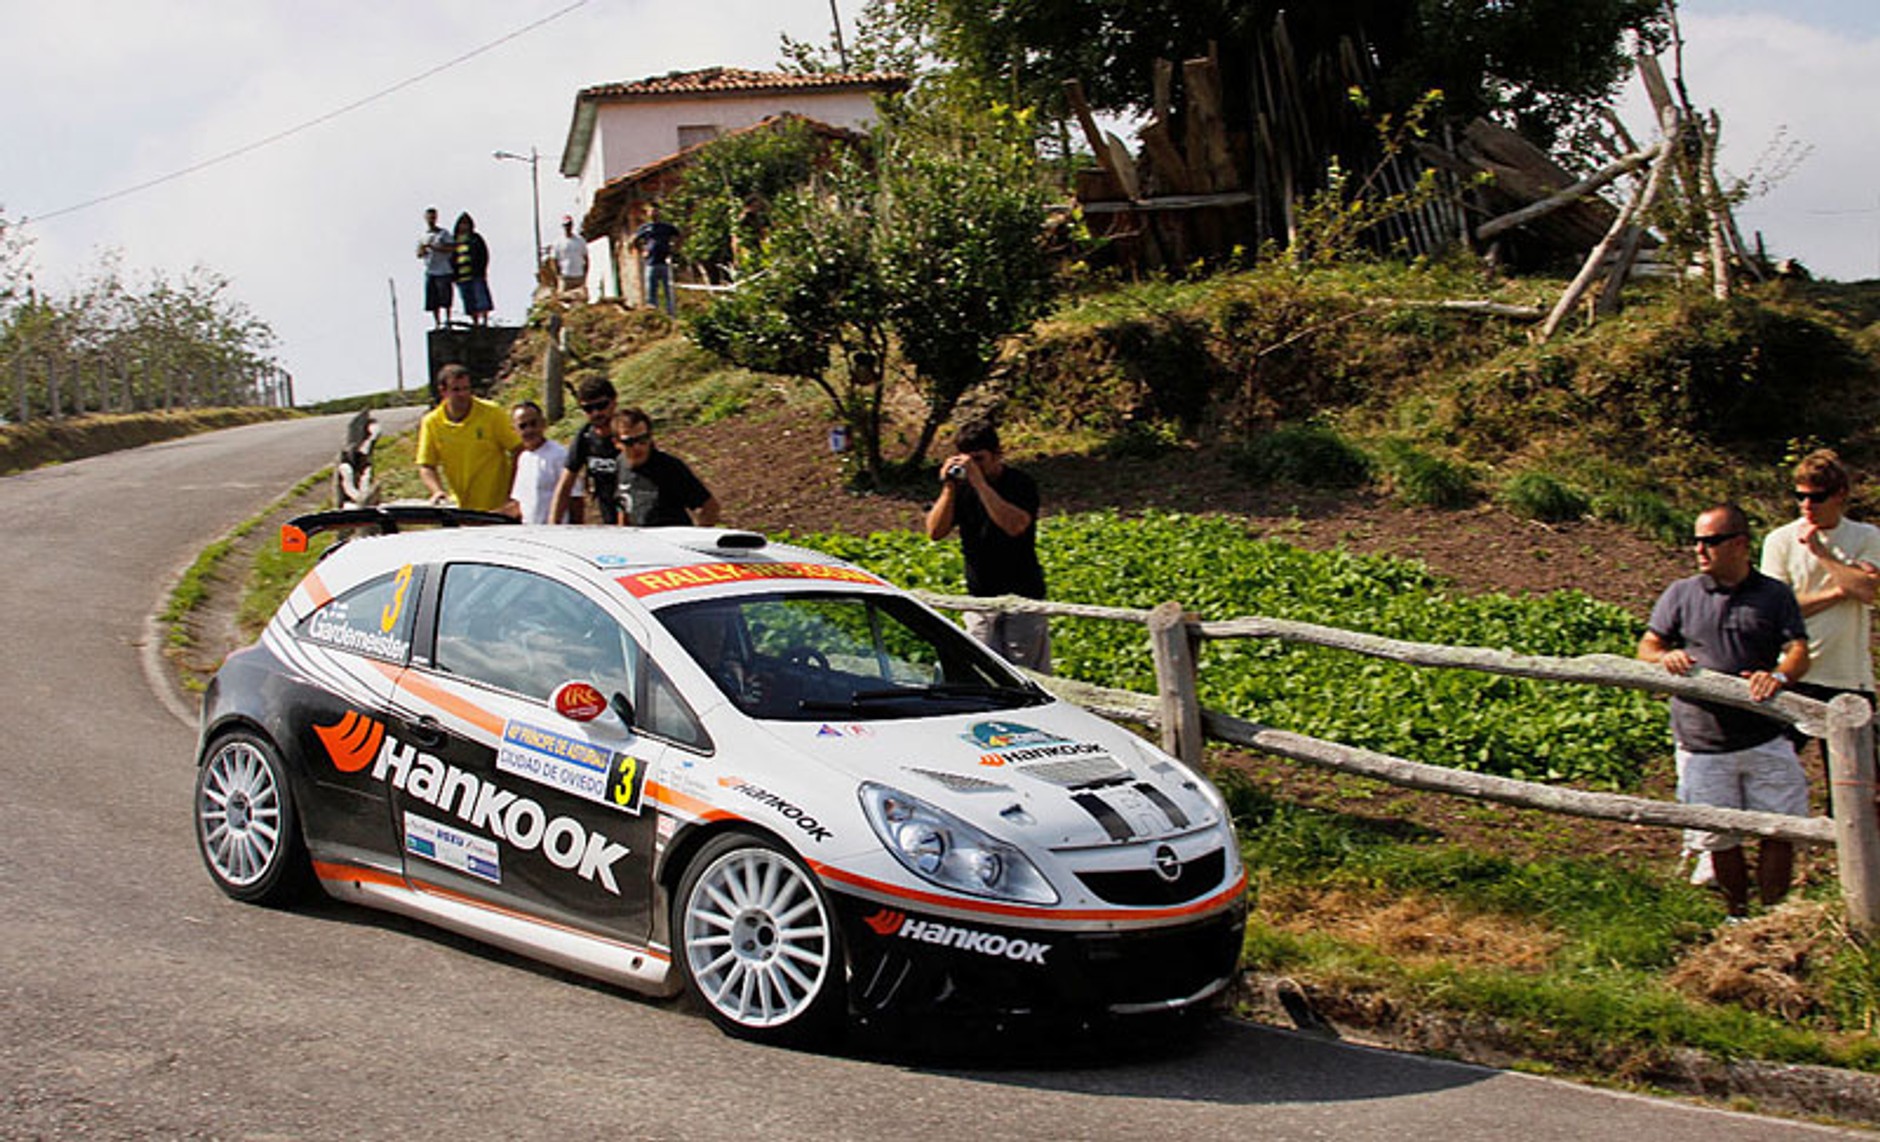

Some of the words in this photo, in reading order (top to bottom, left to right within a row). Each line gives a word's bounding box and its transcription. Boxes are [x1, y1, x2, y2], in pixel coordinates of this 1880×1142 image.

[381, 563, 412, 633] 3
[501, 748, 541, 774] CIUDAD
[542, 761, 558, 780] DE
[560, 768, 604, 795] OVIEDO
[614, 756, 637, 806] 3
